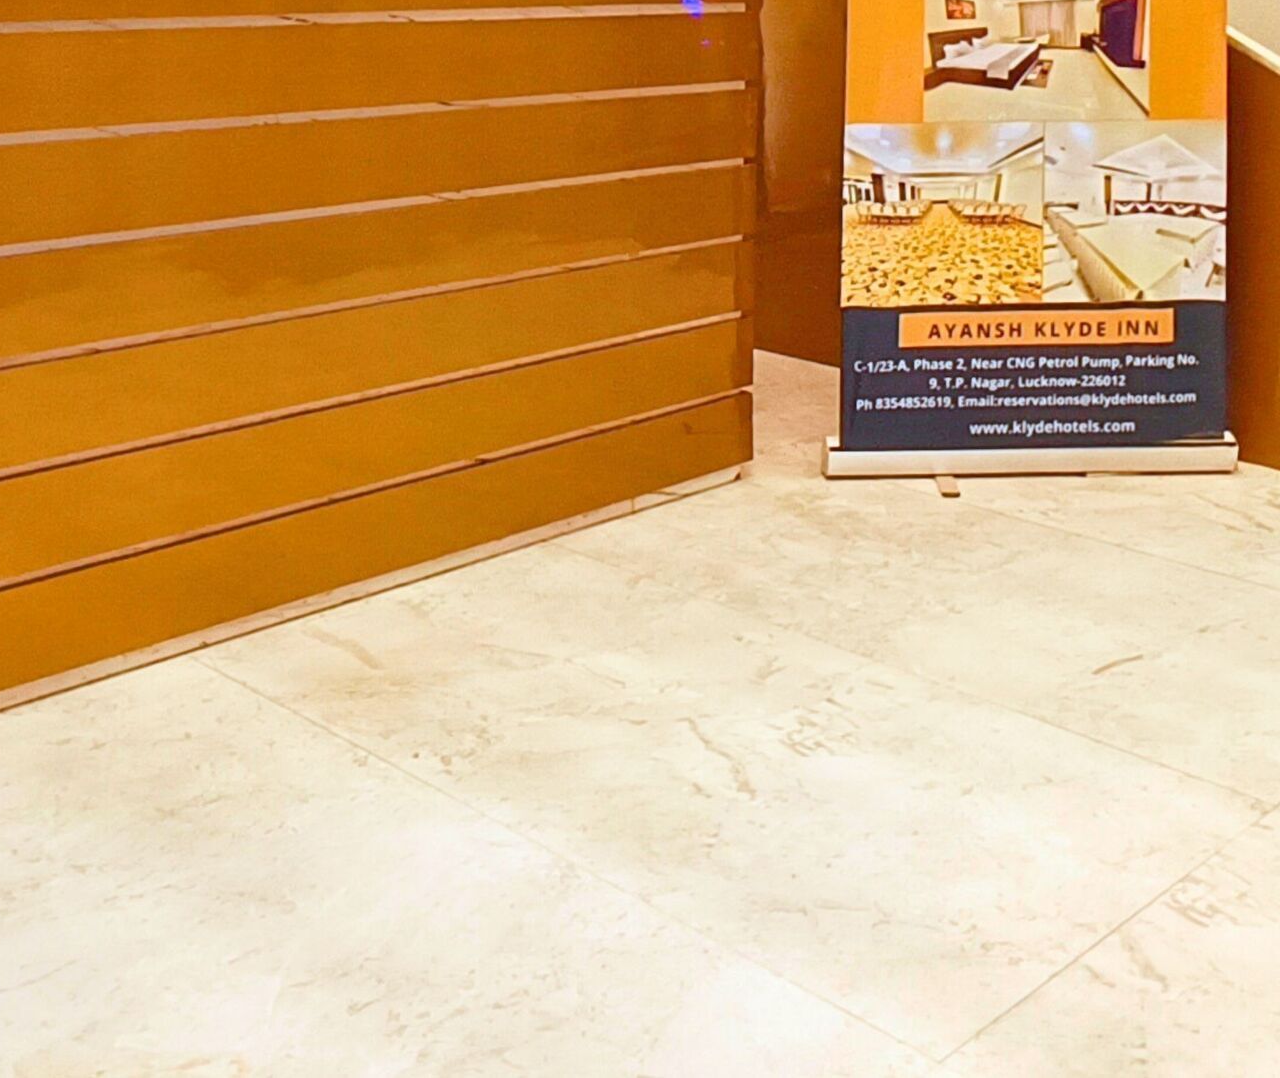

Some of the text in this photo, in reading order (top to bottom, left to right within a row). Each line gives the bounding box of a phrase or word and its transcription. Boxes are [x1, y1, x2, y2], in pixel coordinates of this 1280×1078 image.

[928, 320, 1159, 339] AYANSH KLYDE INN
[854, 354, 1199, 373] C-1/23-A, Phase 2, Near CNG Petrol Pump, Parking No.
[929, 375, 1126, 392] 9, T.P. Nagar, Lucknow-226012
[856, 392, 1197, 411] Ph 8354852619, Email:reservations@klydehotels.com
[970, 420, 1135, 437] www.klydehotels.com
